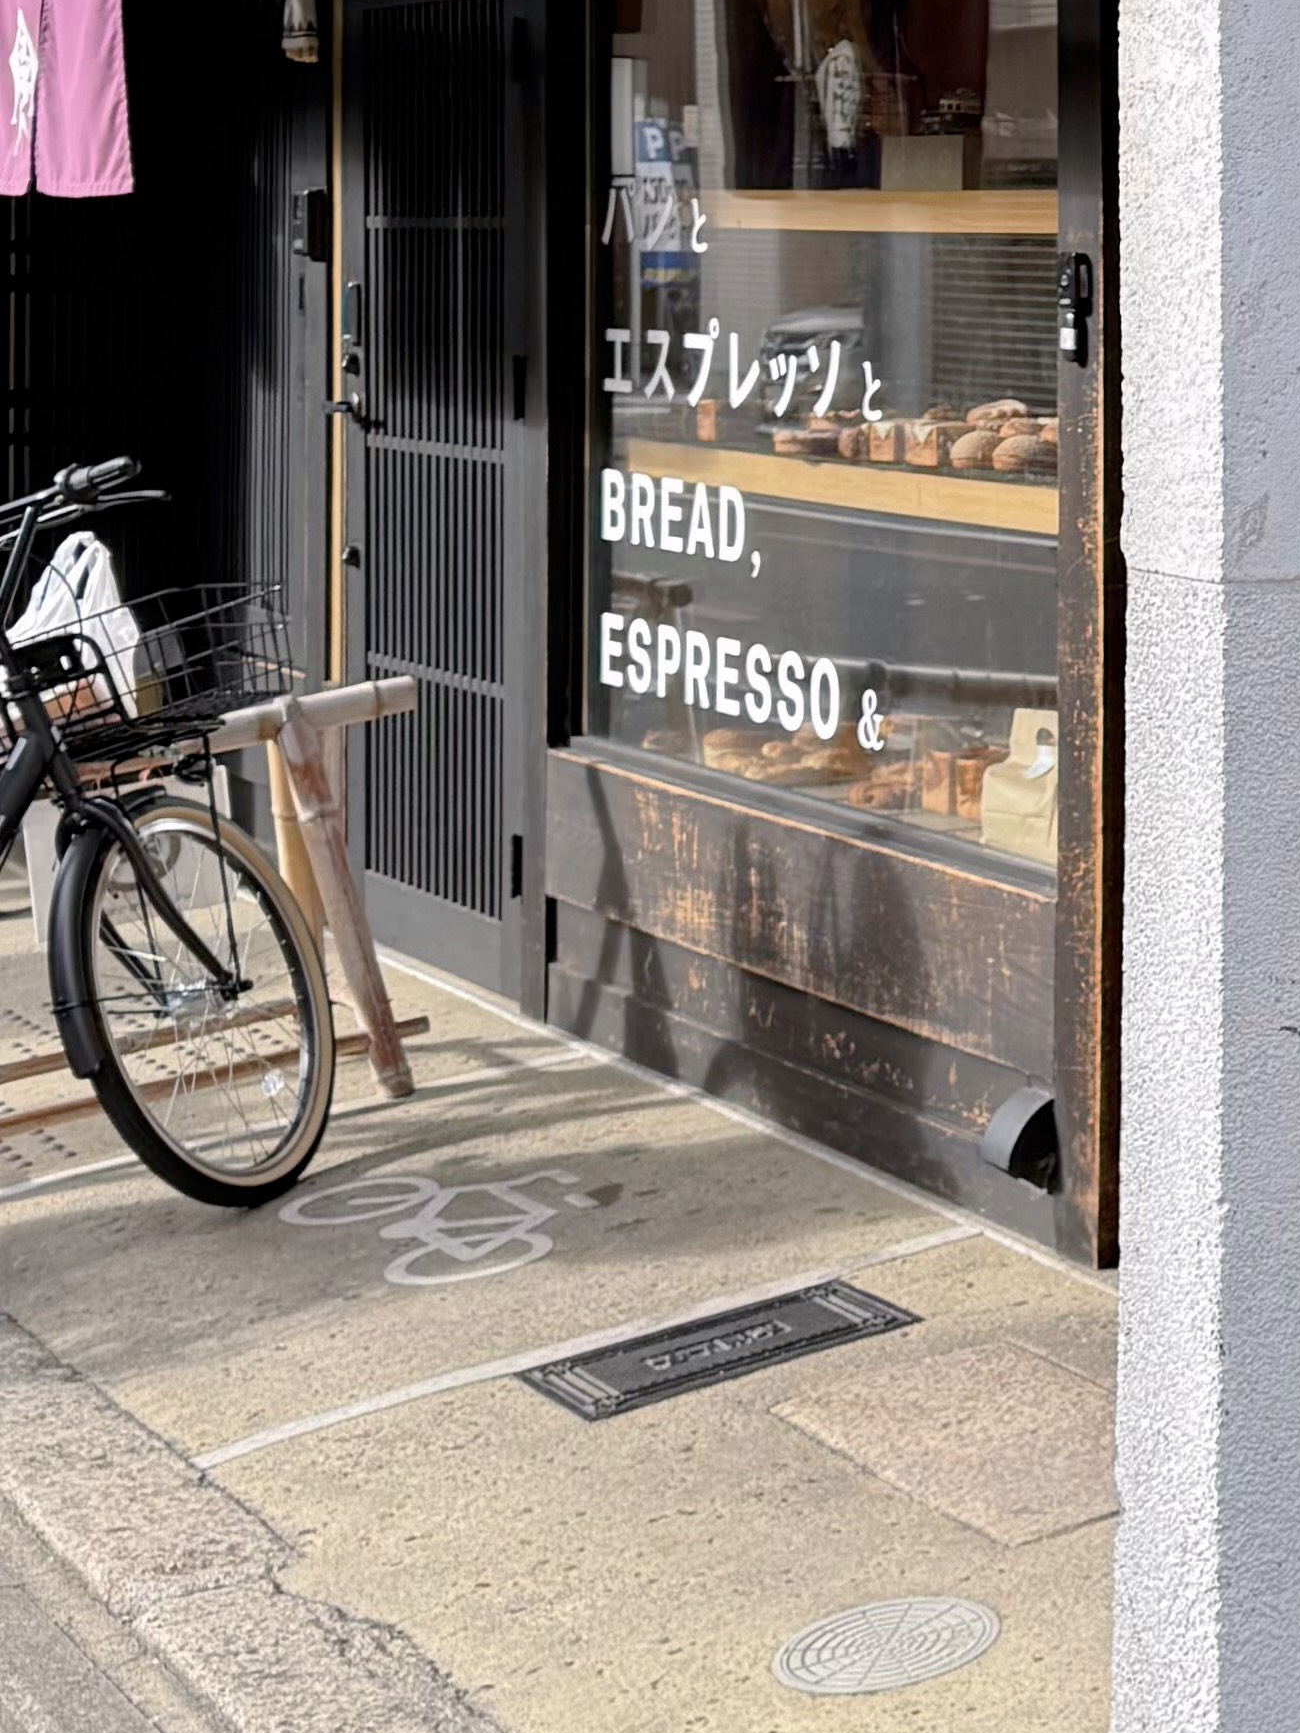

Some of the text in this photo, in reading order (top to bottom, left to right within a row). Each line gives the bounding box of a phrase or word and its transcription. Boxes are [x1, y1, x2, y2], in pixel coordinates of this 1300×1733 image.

[604, 317, 882, 421] エスプレッソと
[601, 468, 761, 578] BREAD,
[600, 612, 885, 751] ESPRESSO &
